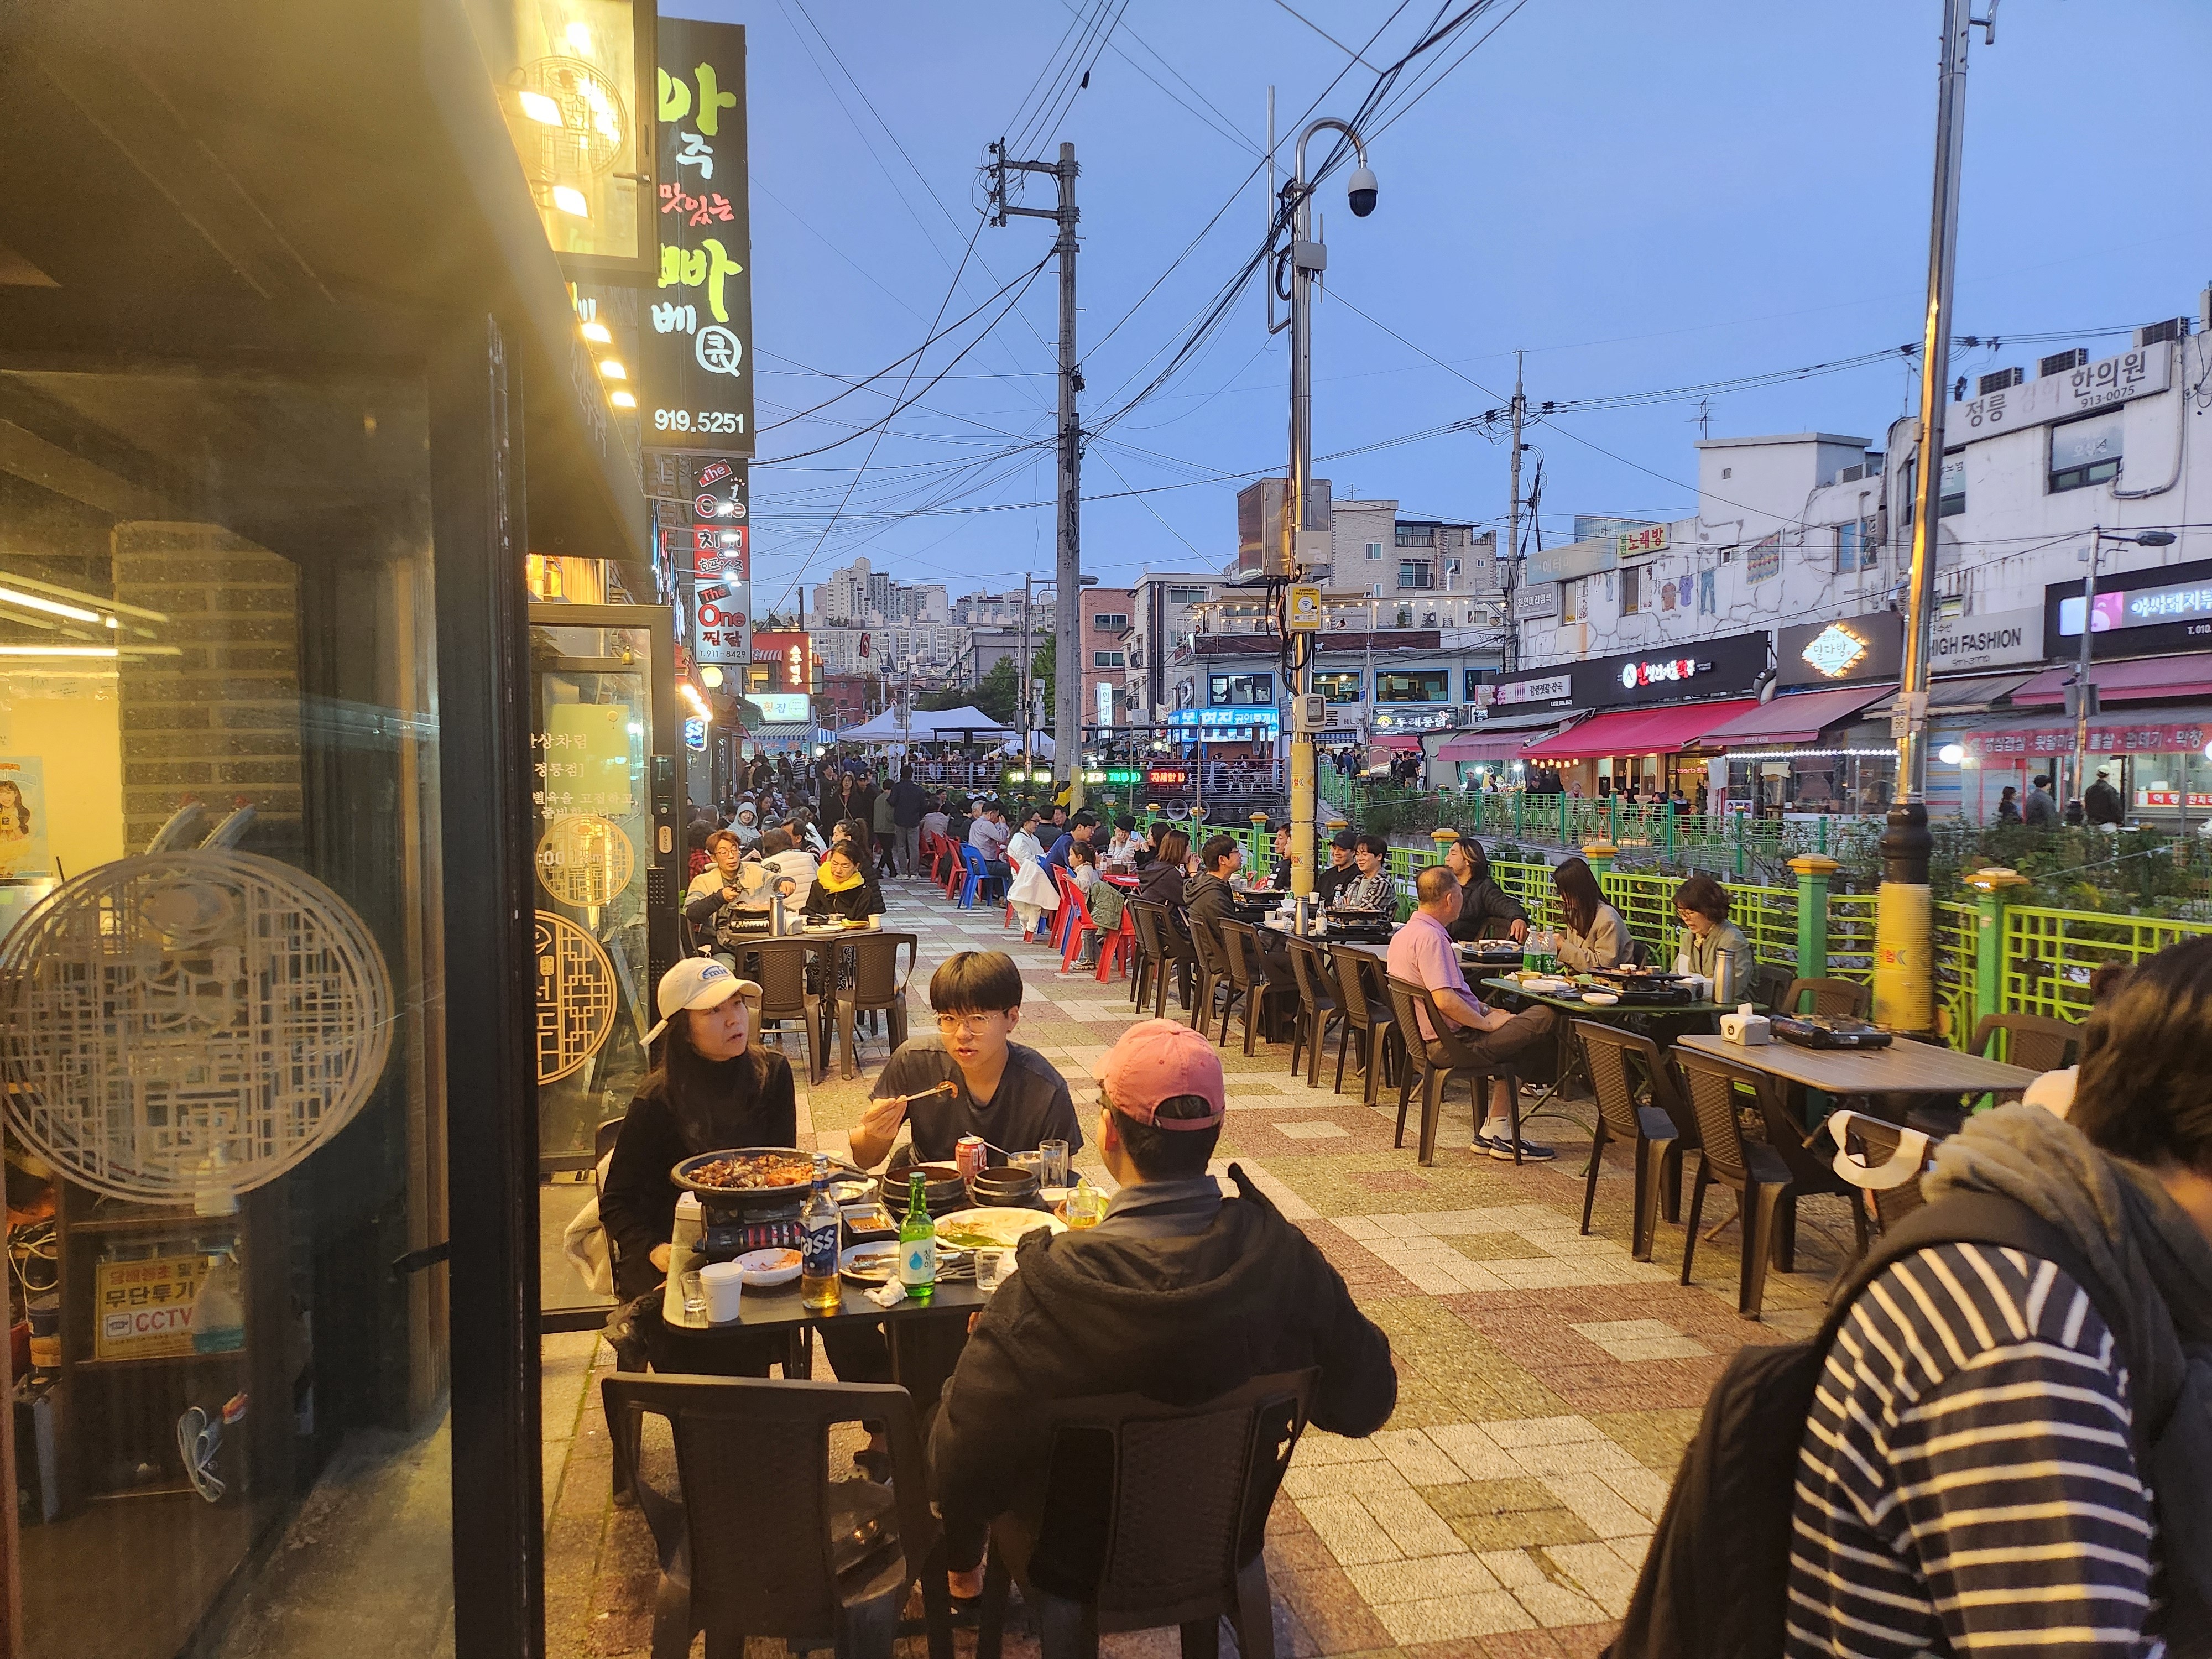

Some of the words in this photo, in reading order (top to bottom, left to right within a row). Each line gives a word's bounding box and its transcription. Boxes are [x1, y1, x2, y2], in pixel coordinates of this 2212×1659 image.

[660, 182, 734, 226] 맛있는
[1965, 393, 2007, 427] 정릉
[2071, 351, 2146, 398] 한의원
[2081, 385, 2135, 408] 913-0075
[655, 409, 744, 434] 919.5251
[1628, 527, 1663, 550] 노래방
[701, 587, 726, 602] The
[1517, 592, 1552, 609] 천연머리염색
[698, 603, 746, 628] One
[702, 630, 743, 648] 찜닭
[1814, 640, 1848, 661] 밀다방
[1961, 627, 2022, 653] FASHION
[685, 721, 704, 738] SS
[2176, 729, 2204, 749] 막창
[106, 1281, 194, 1308] 무단투기
[135, 1307, 192, 1332] CCTV
